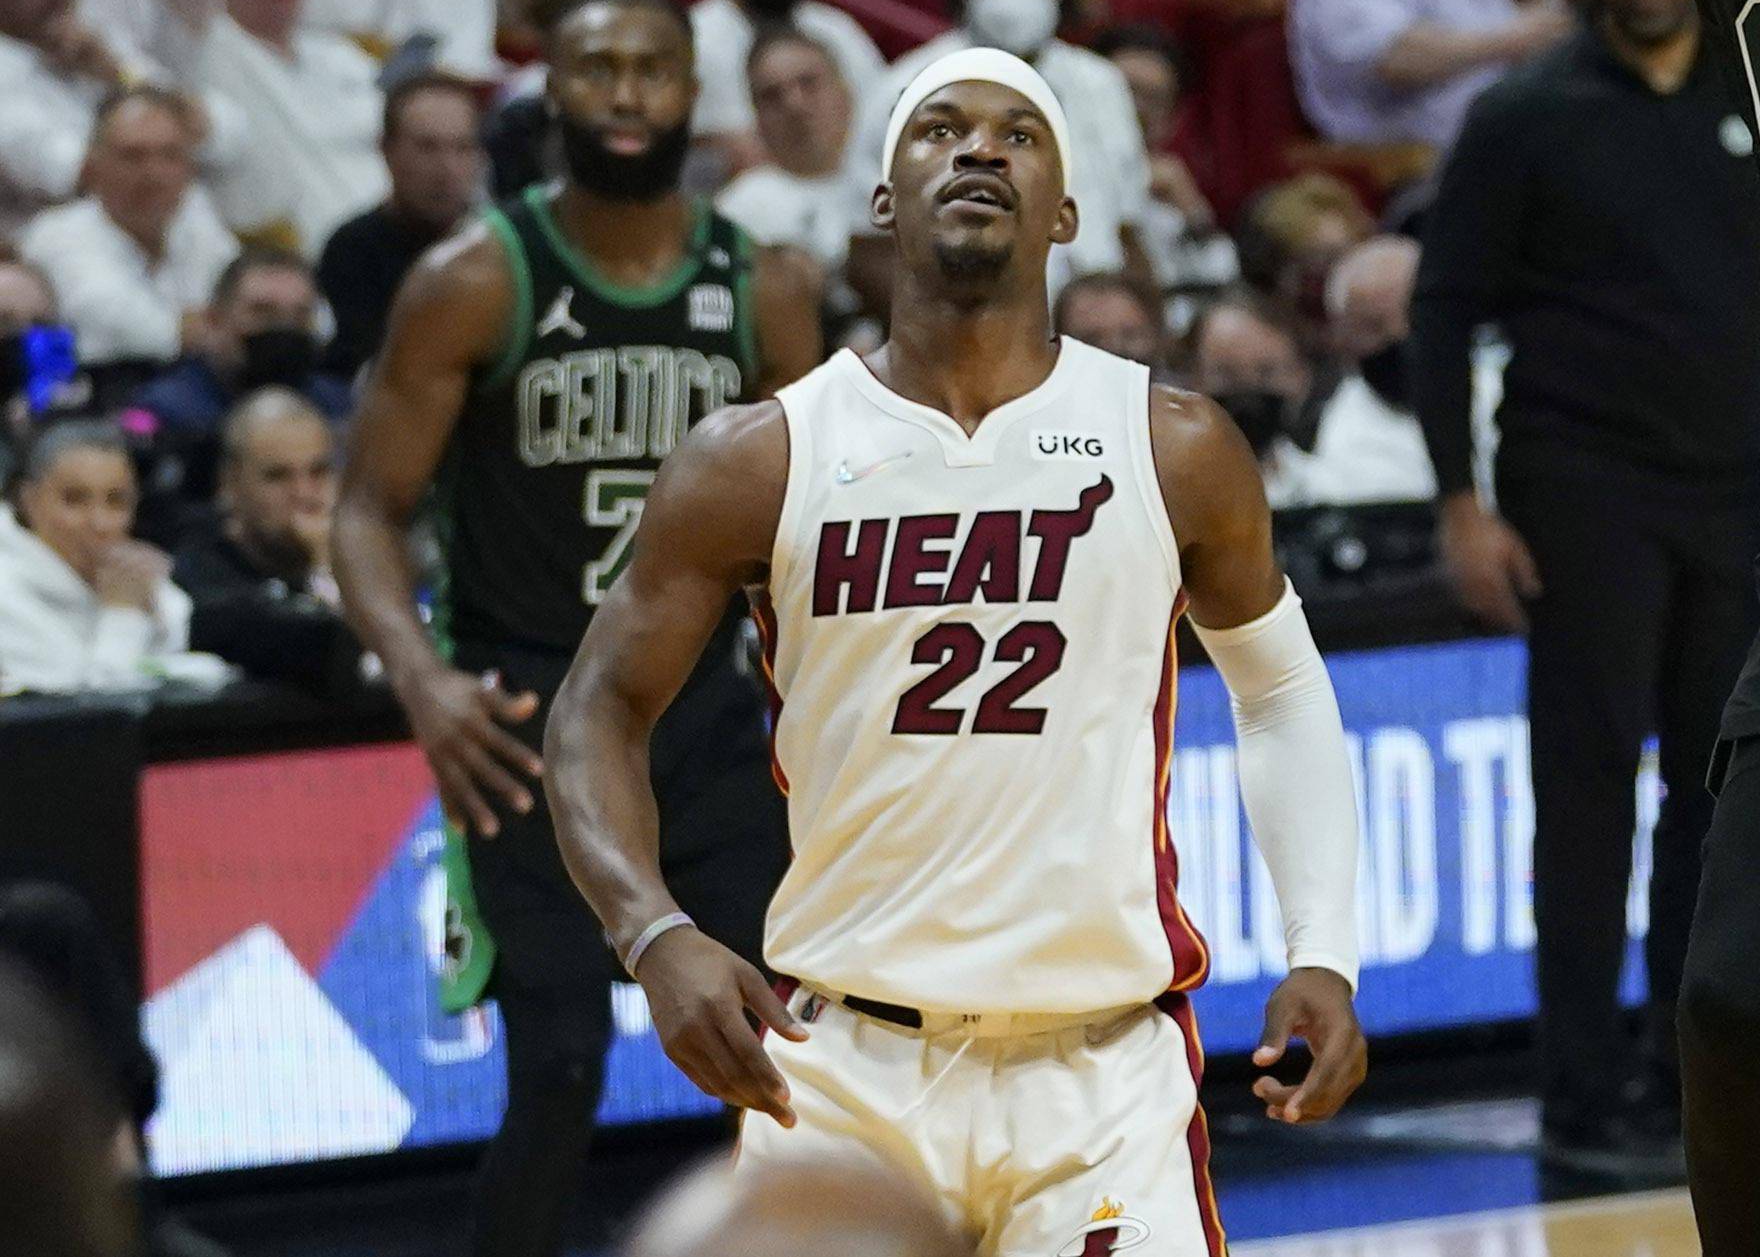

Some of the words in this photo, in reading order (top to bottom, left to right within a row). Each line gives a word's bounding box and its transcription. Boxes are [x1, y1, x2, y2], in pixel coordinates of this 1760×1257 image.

[583, 468, 658, 605] 7
[812, 472, 1114, 617] HEAT
[891, 621, 1068, 735] 22
